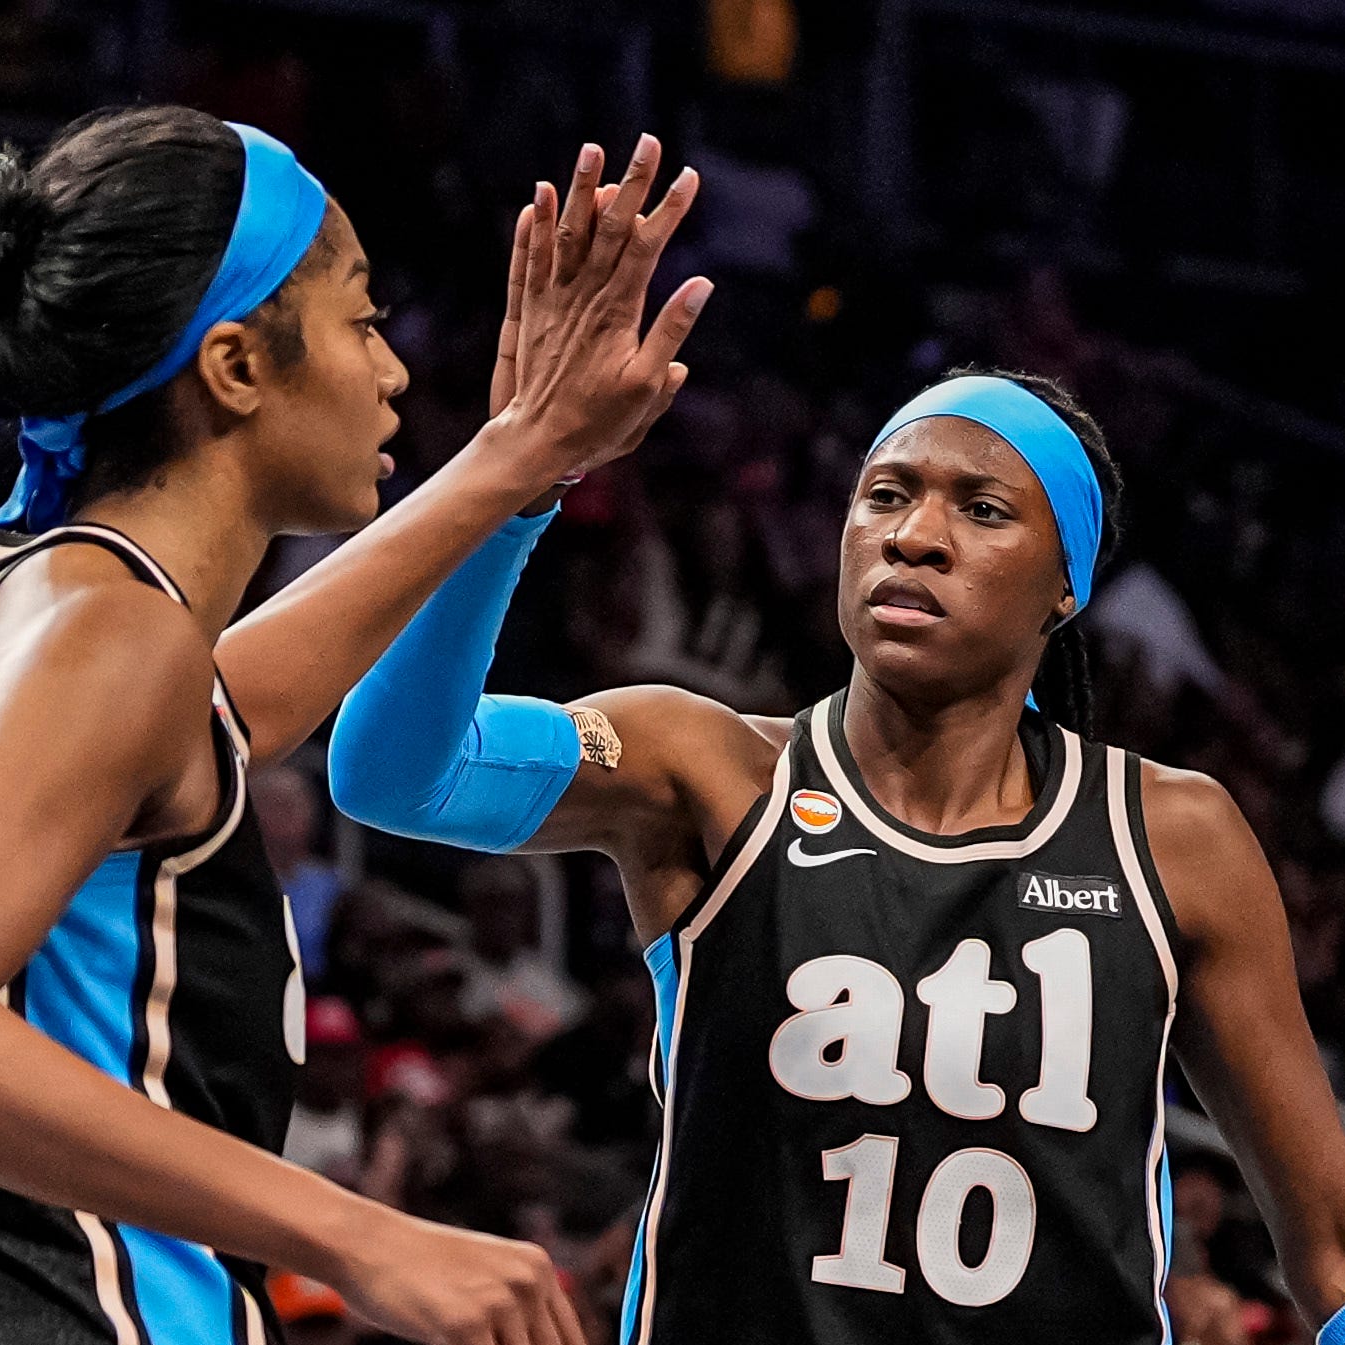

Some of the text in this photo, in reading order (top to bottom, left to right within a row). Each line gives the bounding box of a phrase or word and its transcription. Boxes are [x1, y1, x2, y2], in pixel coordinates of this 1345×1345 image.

[1021, 875, 1119, 913] Albert
[768, 927, 1098, 1133] atl
[811, 1132, 1037, 1308] 10
